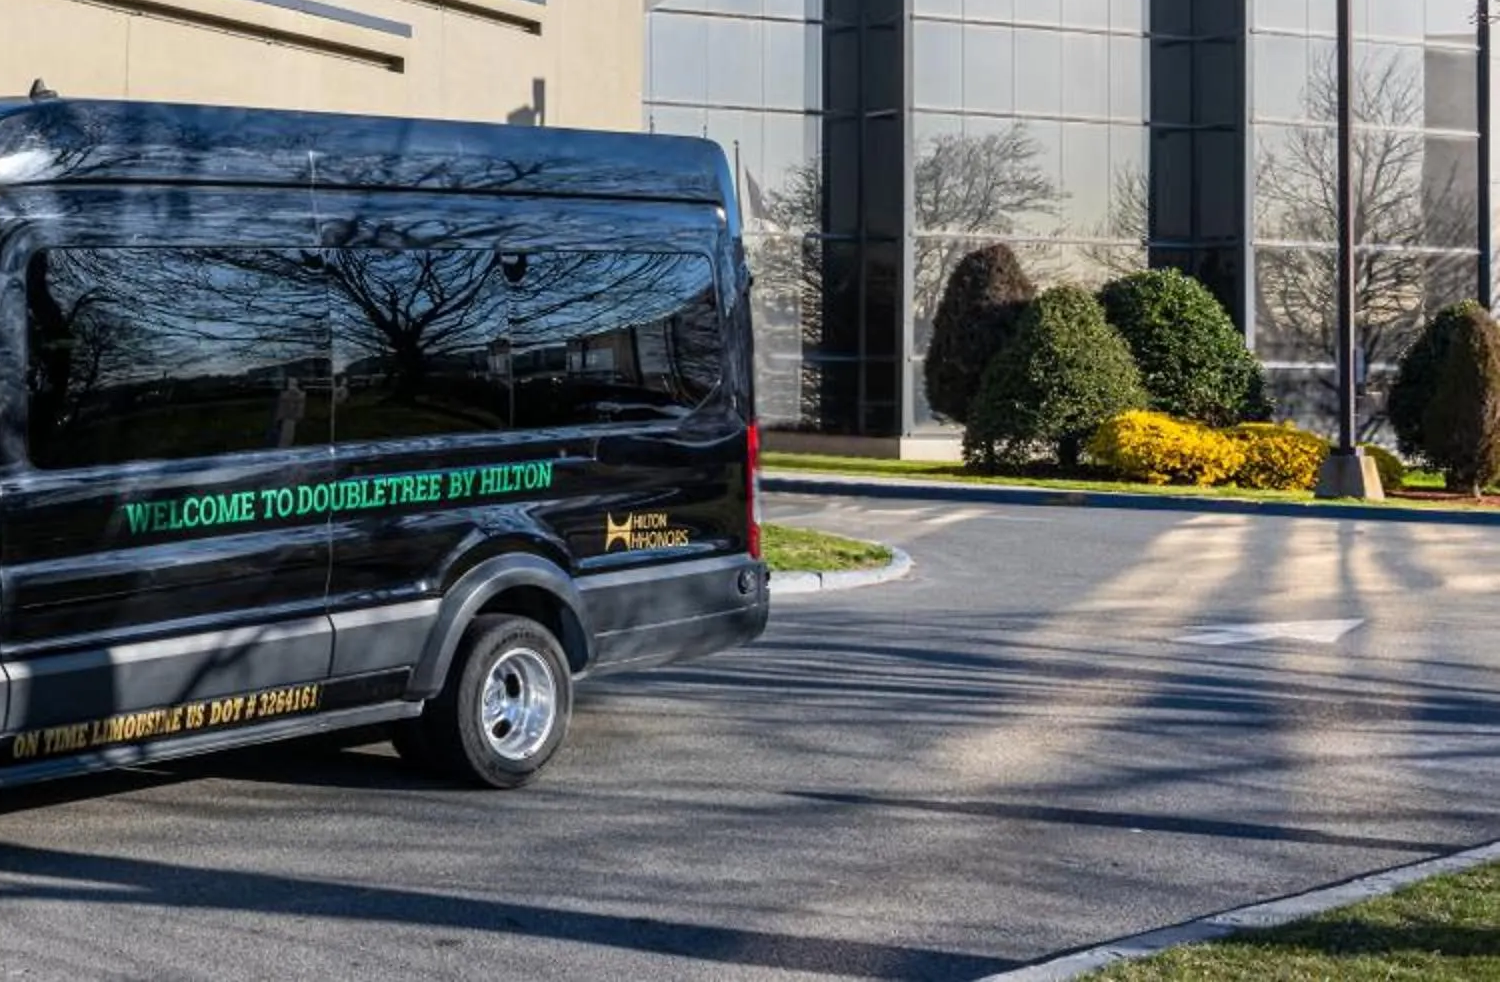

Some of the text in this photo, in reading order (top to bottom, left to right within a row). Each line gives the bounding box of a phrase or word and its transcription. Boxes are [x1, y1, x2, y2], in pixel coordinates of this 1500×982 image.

[126, 461, 554, 535] WELCOME TO DOUBLETREE BY HILTON
[633, 513, 668, 529] HILTON
[13, 730, 40, 759] ON
[44, 721, 89, 753] TIME
[92, 706, 182, 745] LIMOUSINE
[186, 700, 205, 729] US
[209, 696, 244, 725] DOT
[258, 682, 319, 717] 3264161
